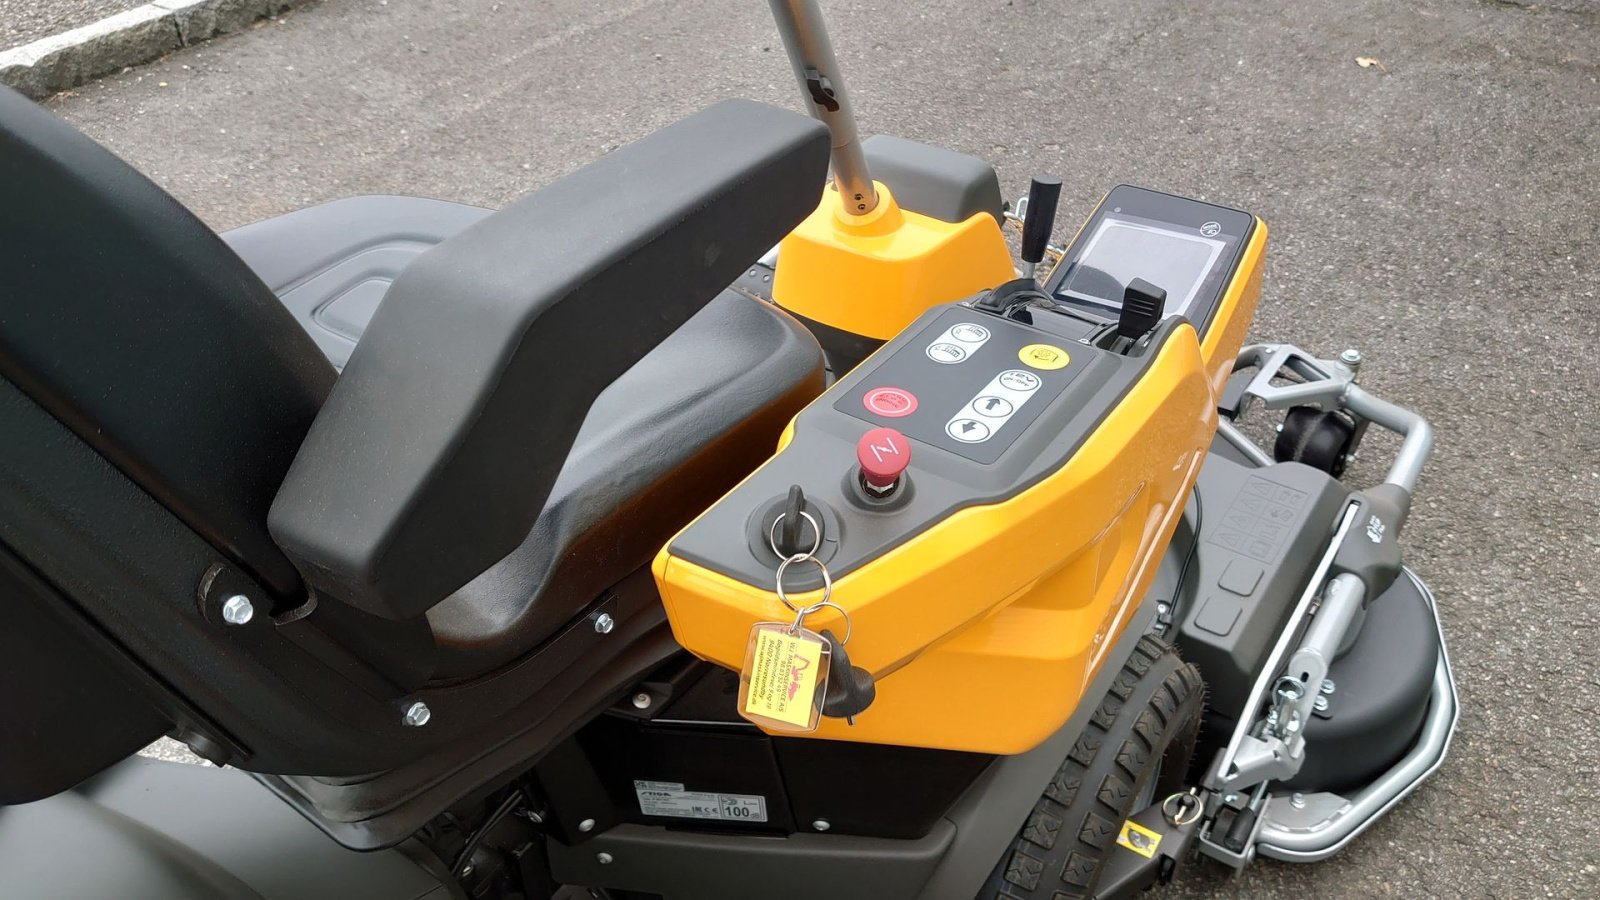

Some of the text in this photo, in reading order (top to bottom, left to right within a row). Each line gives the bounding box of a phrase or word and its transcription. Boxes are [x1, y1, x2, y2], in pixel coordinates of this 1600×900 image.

[767, 640, 775, 658] 9400
[780, 654, 793, 702] MASKINSERVICE
[725, 806, 750, 817] 100
